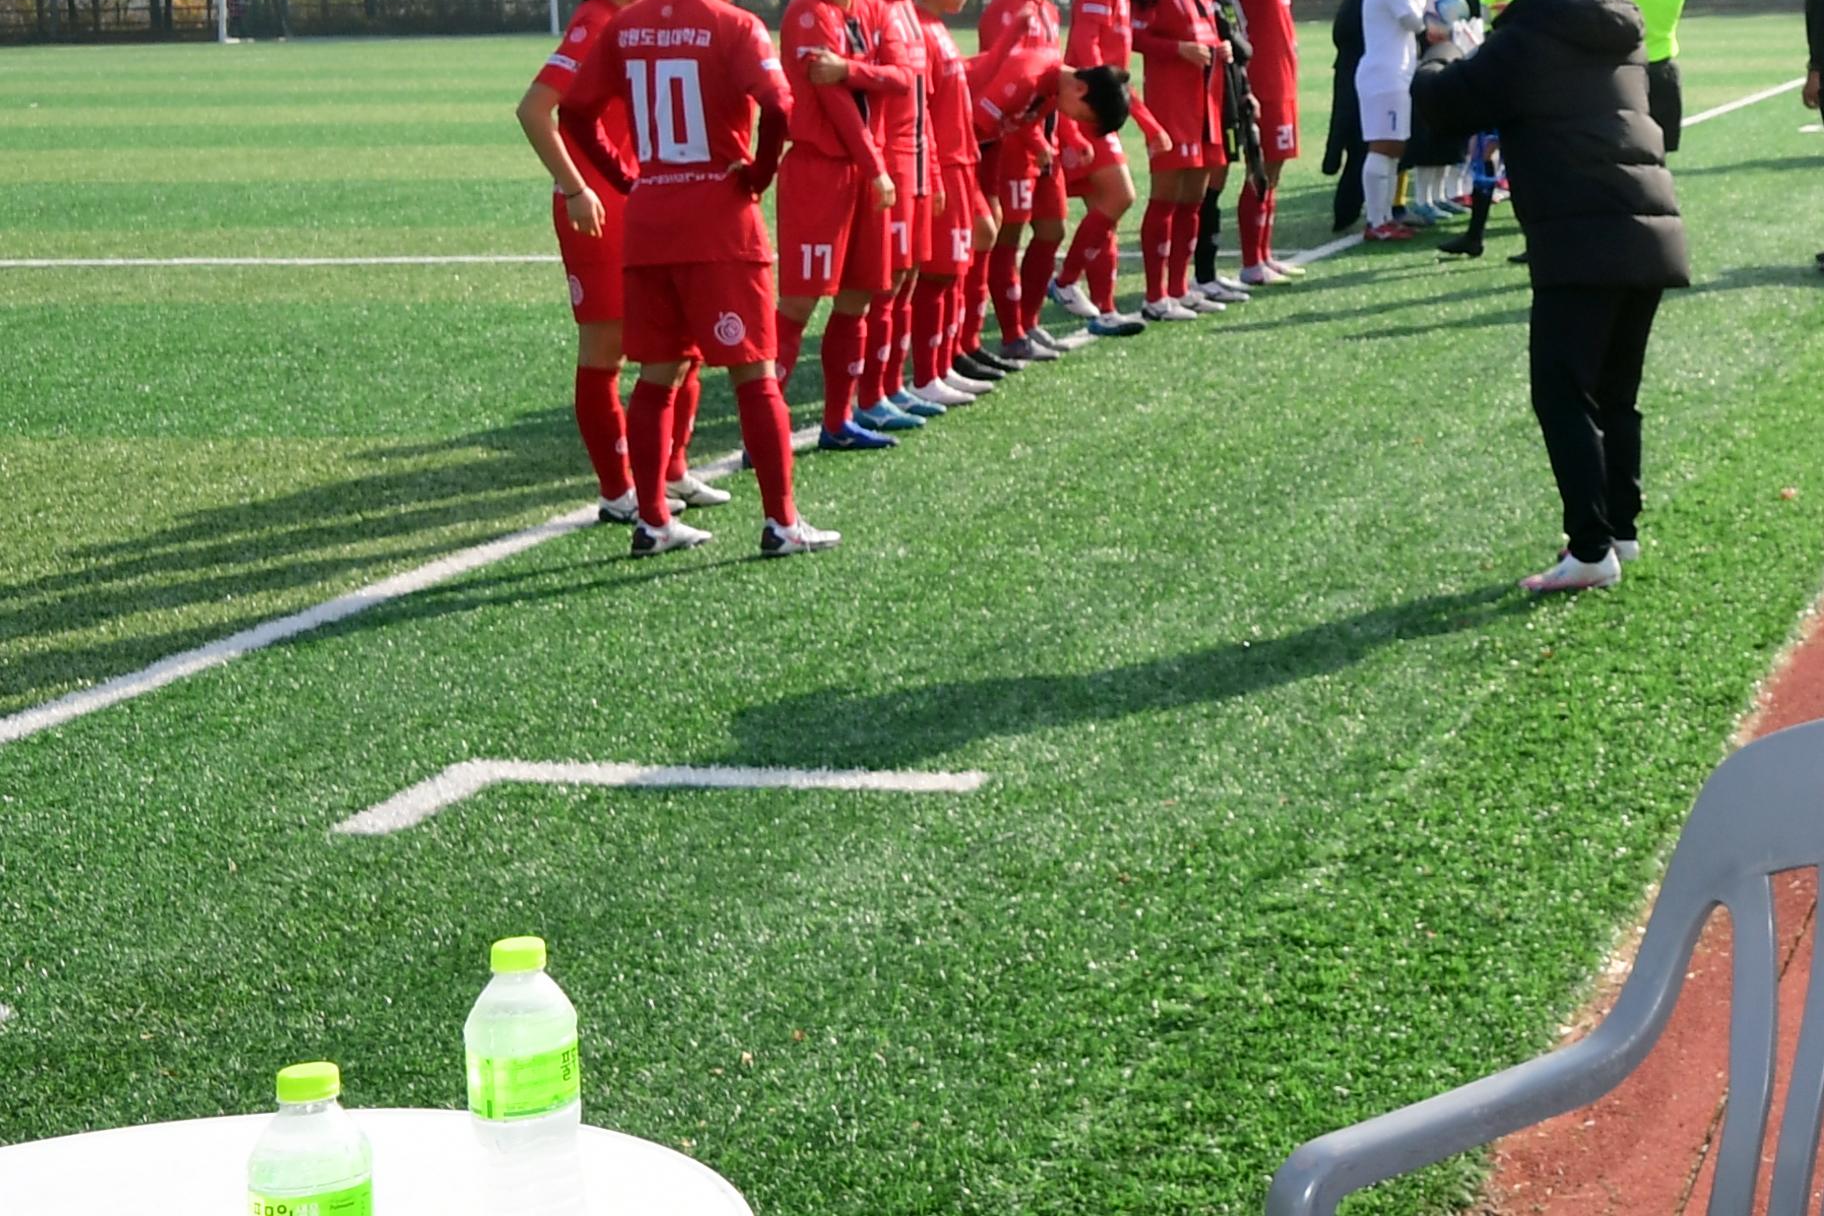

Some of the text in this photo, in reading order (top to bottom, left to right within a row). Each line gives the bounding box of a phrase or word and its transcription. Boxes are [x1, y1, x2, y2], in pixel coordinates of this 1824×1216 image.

[618, 28, 712, 48] 강원도립대학교
[625, 59, 711, 164] 10
[1388, 110, 1397, 131] 7
[1010, 179, 1032, 210] 15
[801, 244, 832, 280] 17
